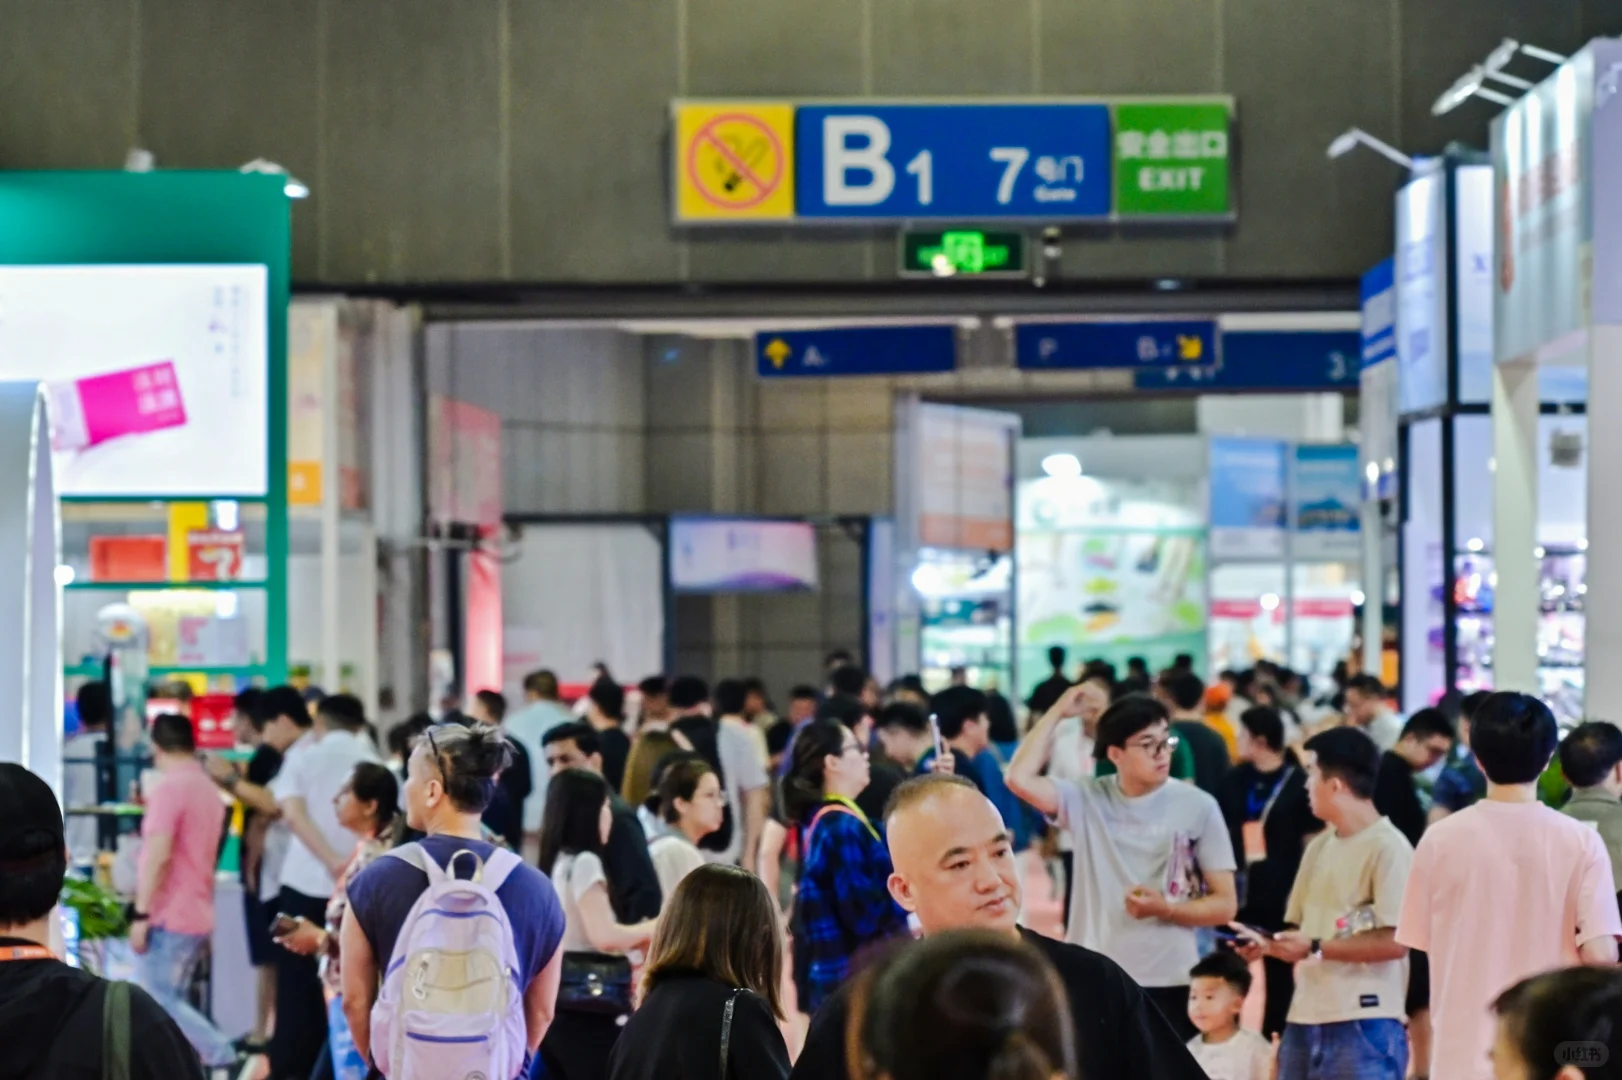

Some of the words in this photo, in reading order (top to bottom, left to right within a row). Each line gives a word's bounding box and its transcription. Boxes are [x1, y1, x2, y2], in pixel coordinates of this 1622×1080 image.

[1118, 130, 1227, 159] 安全出口
[1139, 166, 1206, 192] EXIT
